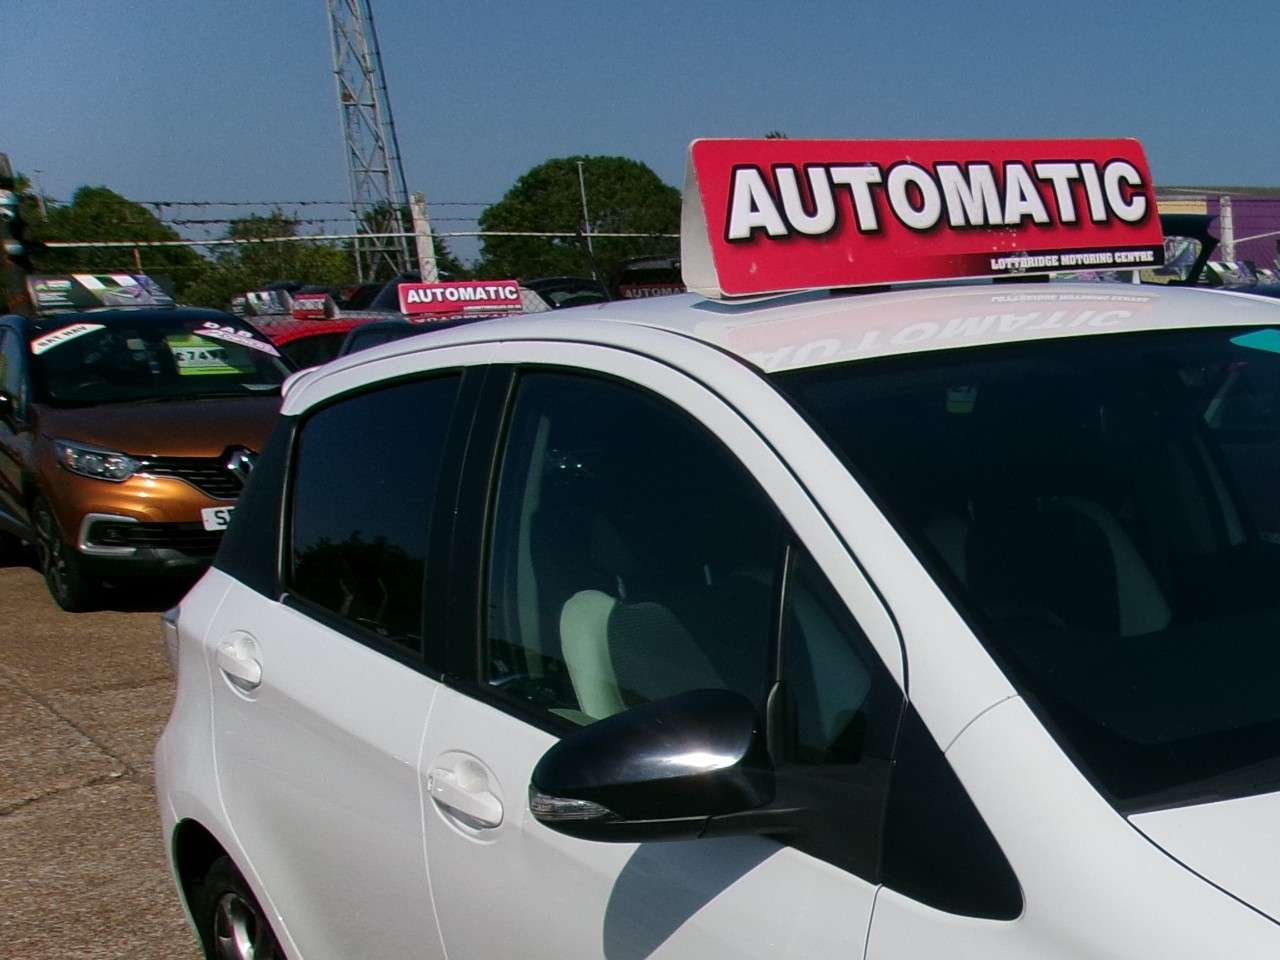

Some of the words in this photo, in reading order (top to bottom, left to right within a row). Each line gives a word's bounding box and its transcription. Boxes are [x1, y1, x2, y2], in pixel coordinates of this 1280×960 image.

[725, 161, 1150, 242] AUTOMATIC
[1060, 252, 1113, 266] MOTORING
[1114, 250, 1154, 263] CENTRE
[407, 286, 518, 304] AUTOMATIC
[203, 321, 254, 339] DAB
